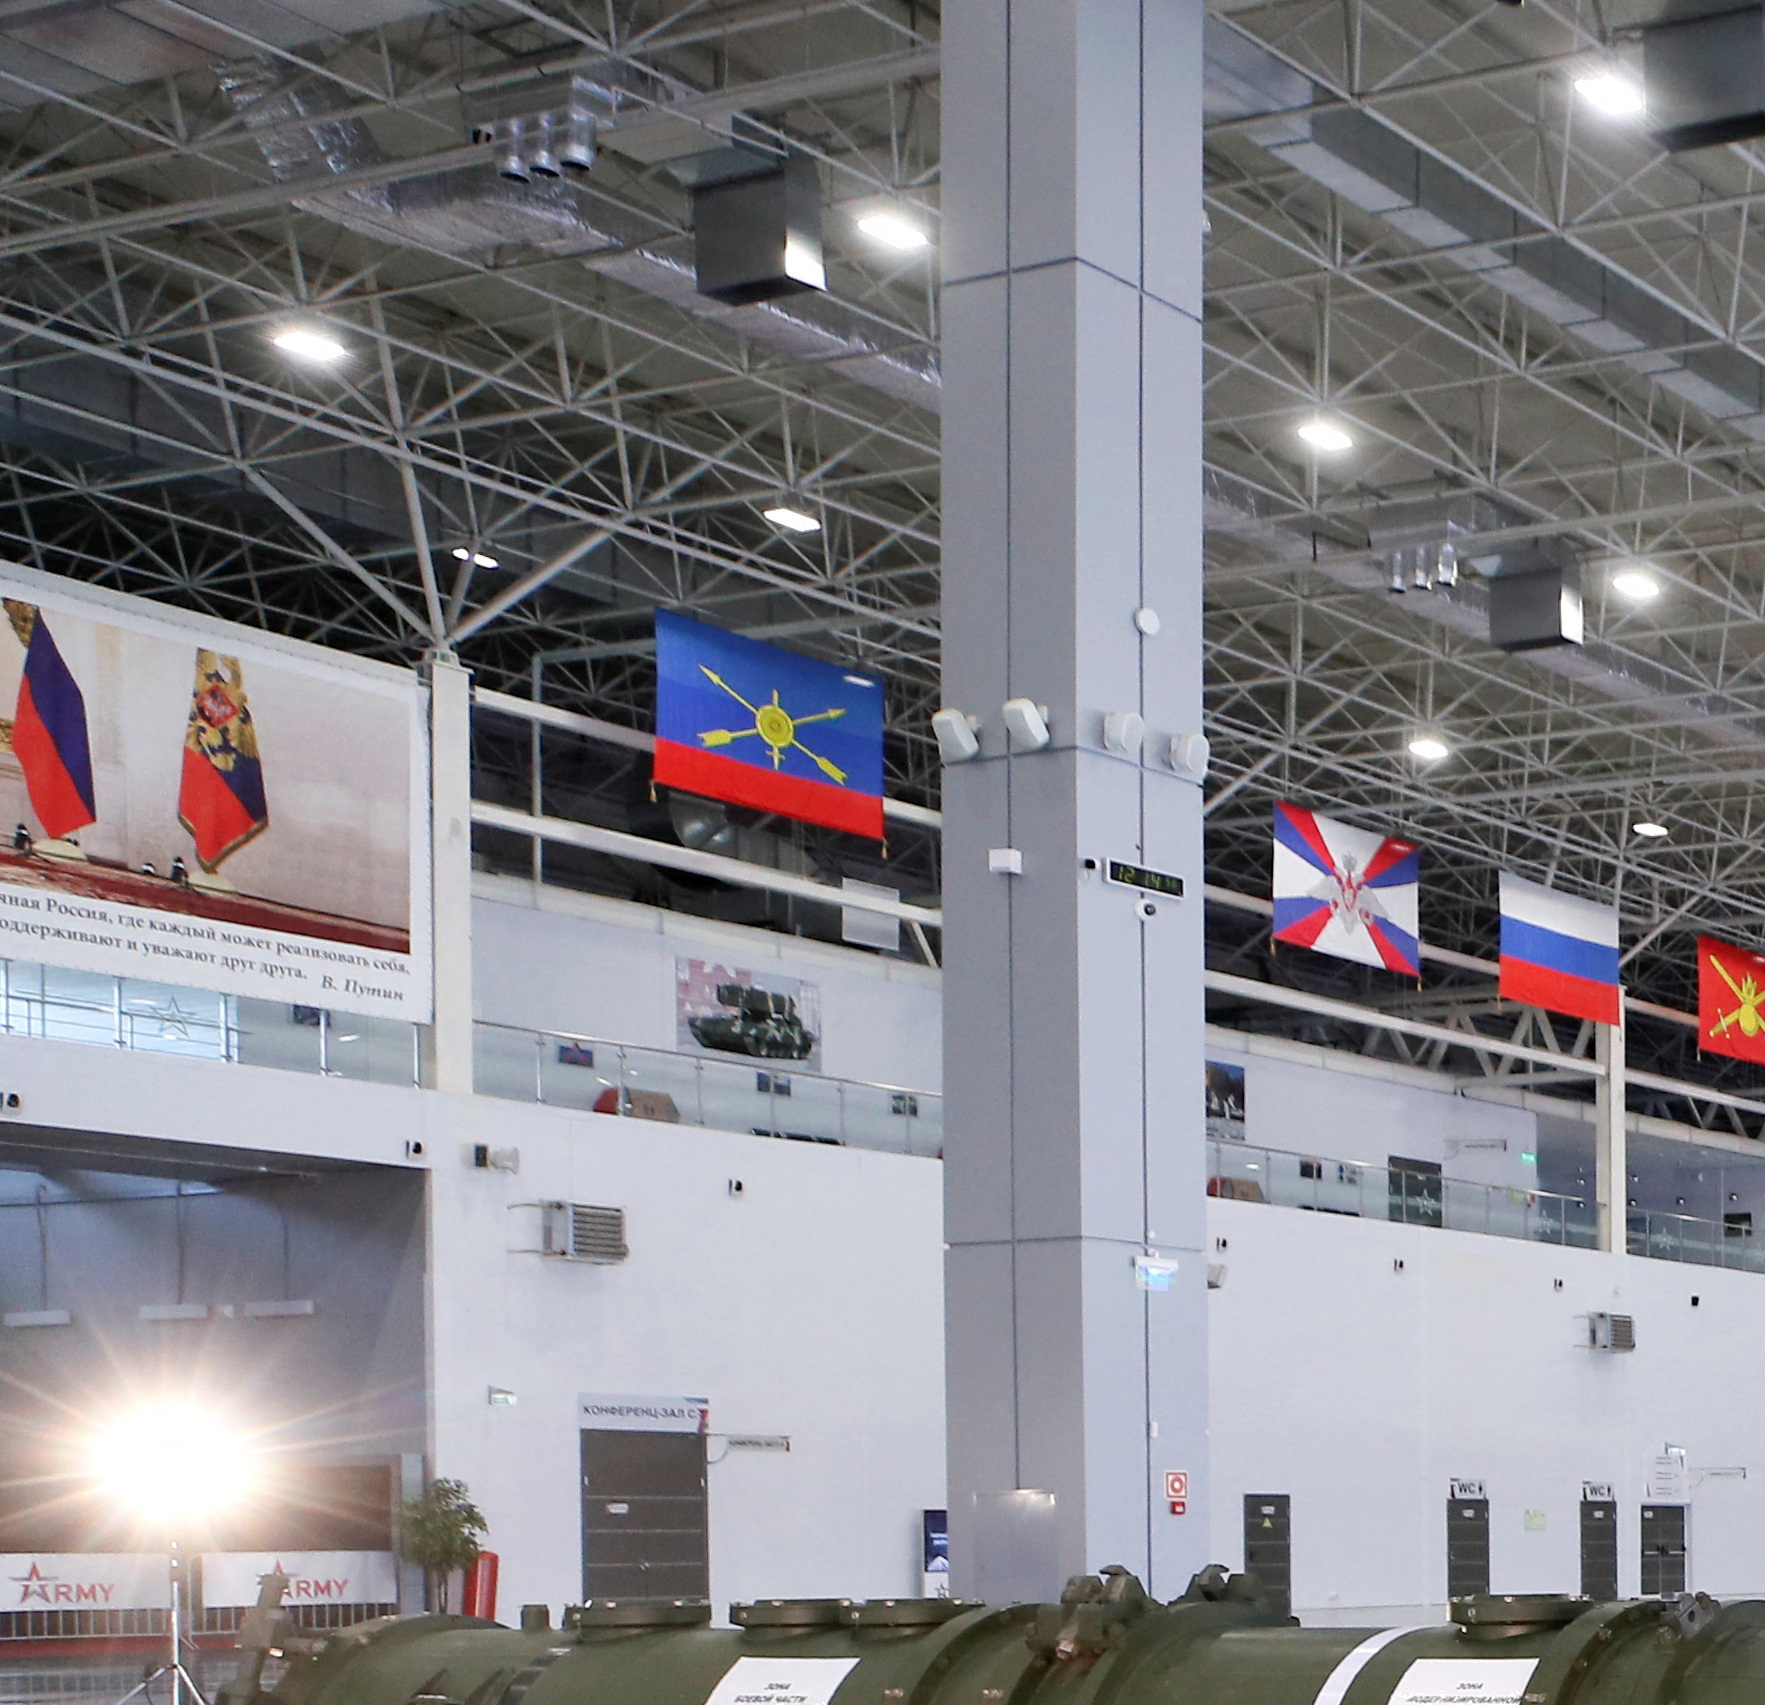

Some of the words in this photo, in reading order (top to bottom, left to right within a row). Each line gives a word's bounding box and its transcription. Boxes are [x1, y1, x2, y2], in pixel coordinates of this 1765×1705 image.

[0, 892, 41, 910] ная
[46, 897, 113, 923] Россия,
[118, 913, 145, 928] где
[149, 919, 217, 941] каждый
[221, 931, 273, 950] может
[276, 941, 370, 967] реализовать
[127, 939, 138, 951] и
[142, 942, 217, 965] уважают
[220, 955, 256, 973] друг
[259, 961, 308, 980] друга.
[322, 974, 338, 991] В.
[344, 977, 404, 1001] Путин
[1458, 1482, 1475, 1494] WC
[1589, 1485, 1605, 1496] WC
[14, 1562, 115, 1604] ARMY
[775, 1695, 807, 1704] ЧАСТИ
